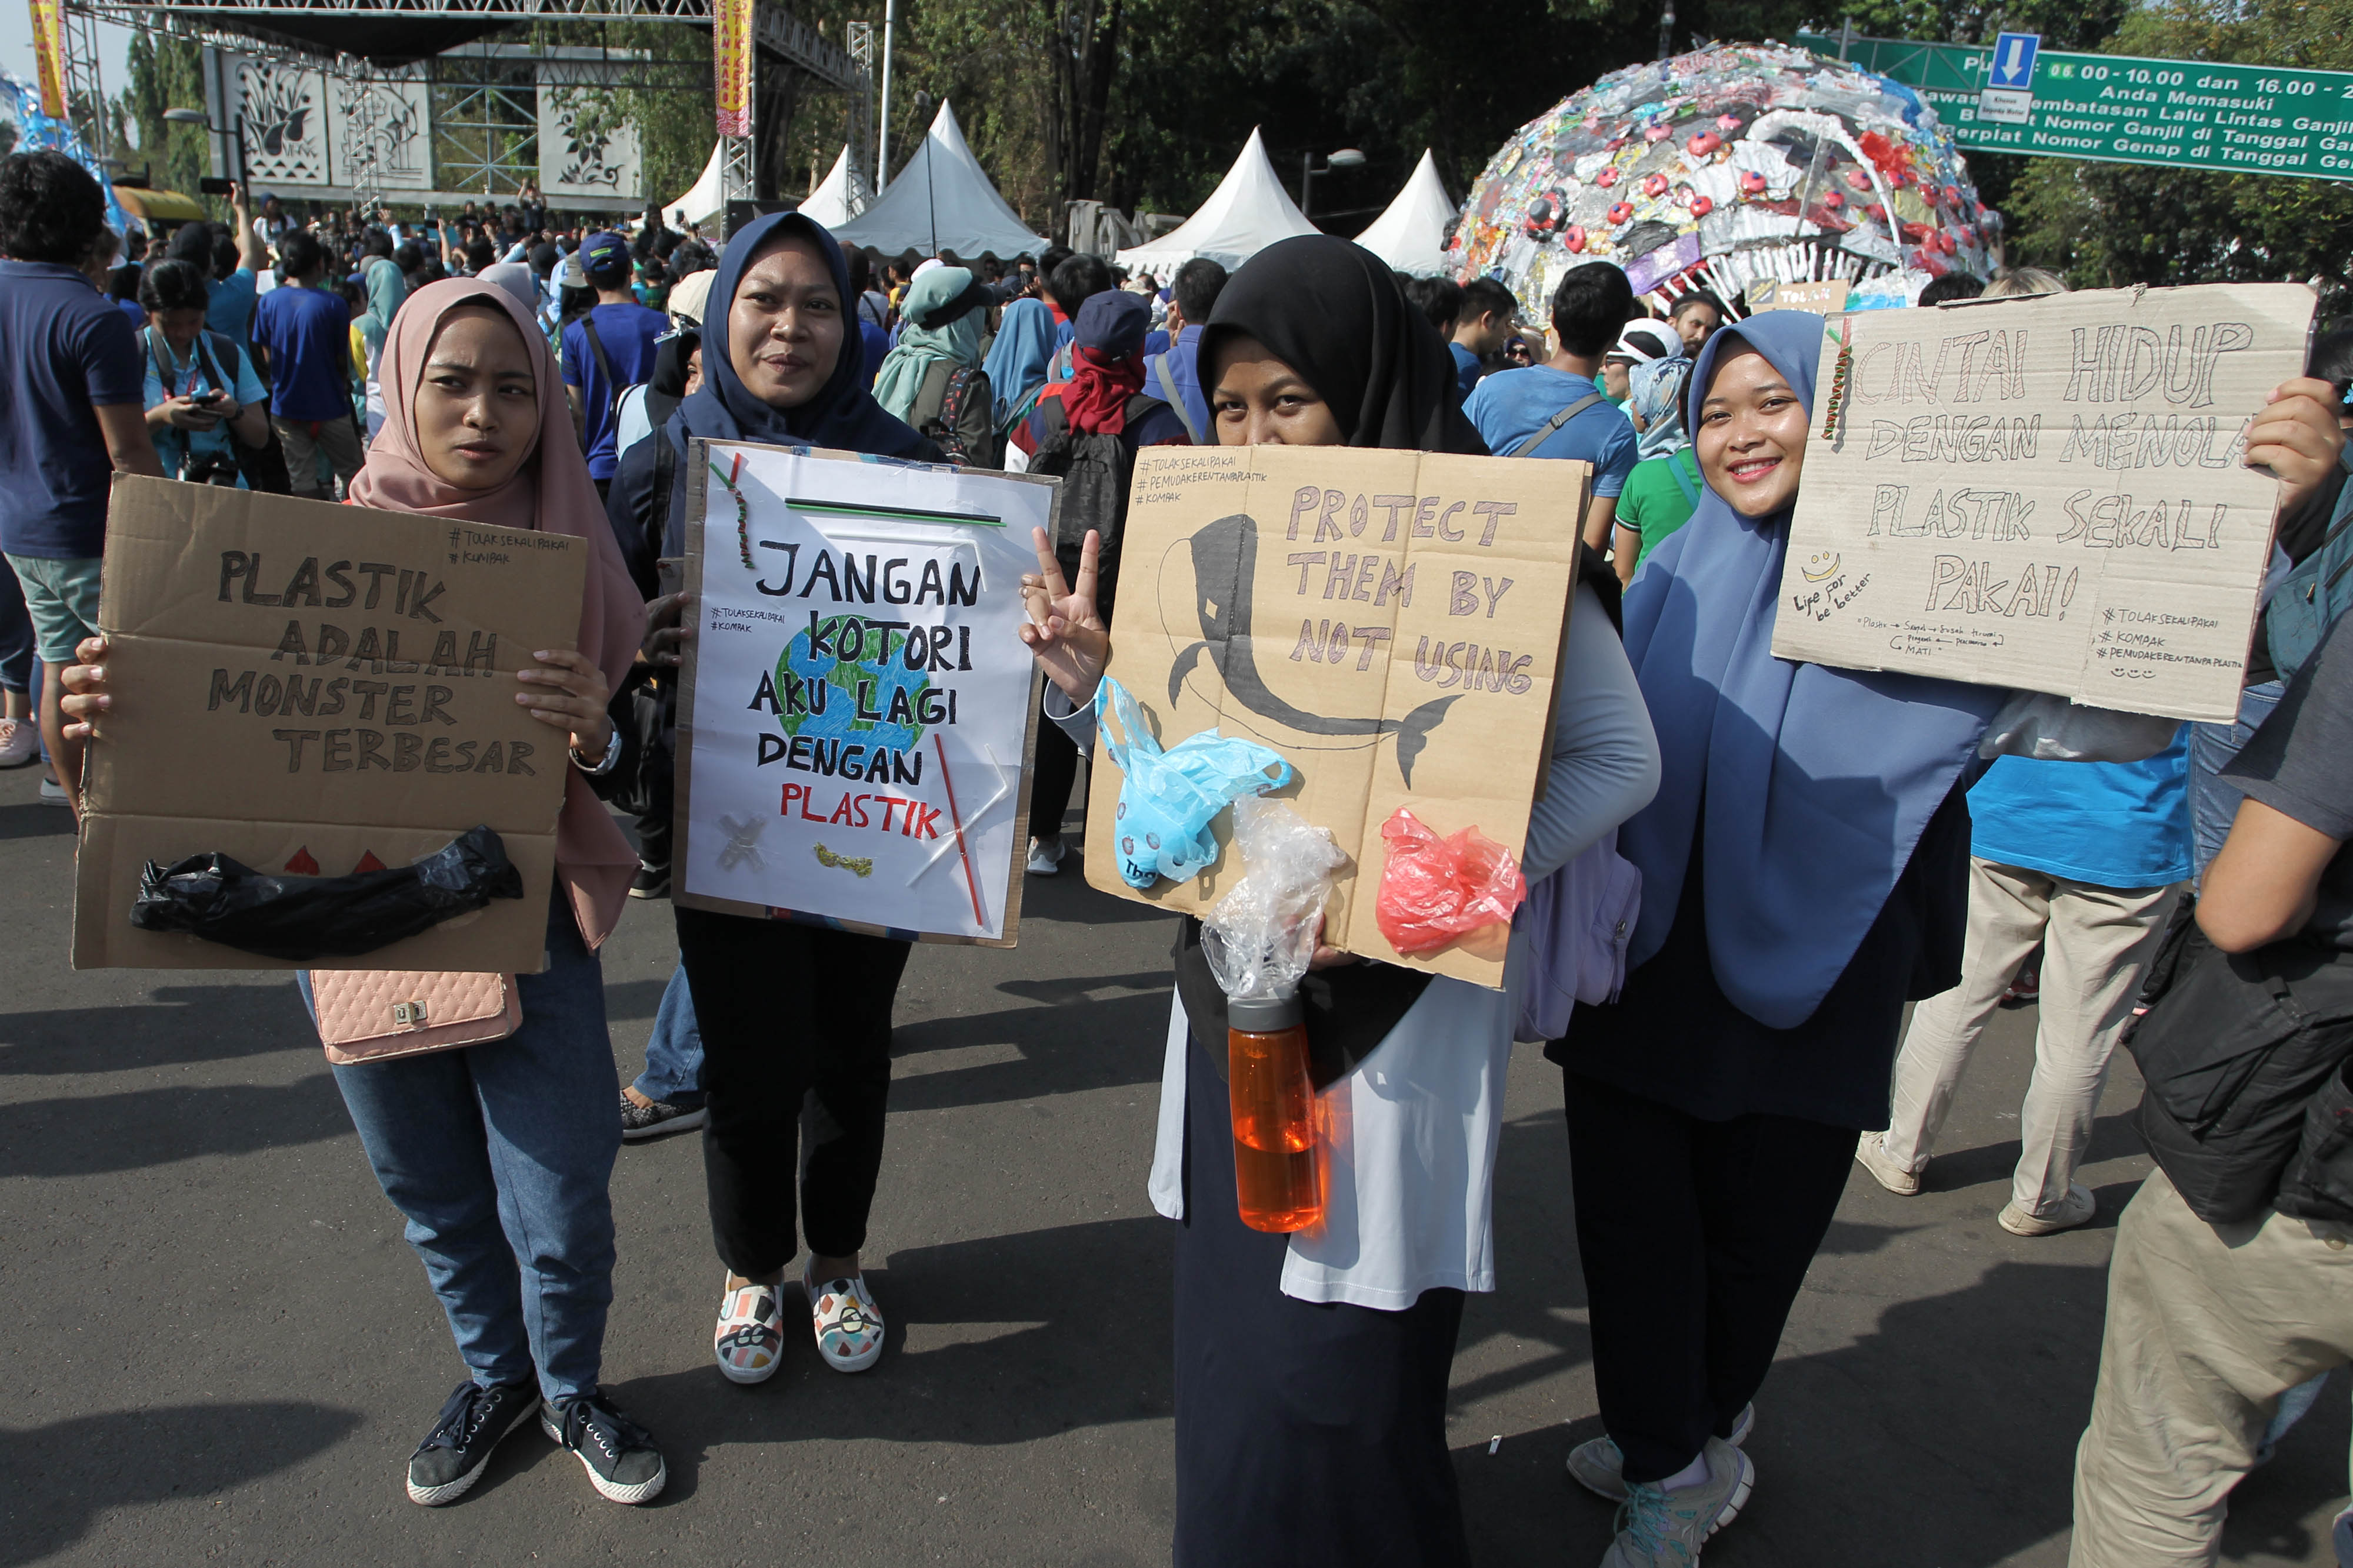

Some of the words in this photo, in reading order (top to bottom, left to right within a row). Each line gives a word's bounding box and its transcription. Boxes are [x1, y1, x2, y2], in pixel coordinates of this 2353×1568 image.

[2099, 85, 2158, 103] Anda
[2167, 91, 2274, 111] Memasuki
[2126, 68, 2184, 86] 10.00
[2196, 75, 2239, 91] dan
[2255, 78, 2316, 96] 16.00
[2031, 94, 2148, 118] embatasan
[2159, 106, 2206, 122] Lalu
[2214, 110, 2282, 129] Lintas
[2292, 116, 2353, 136] Ganjil
[2044, 115, 2115, 134] Nomor
[2123, 120, 2184, 141] Ganjil
[2192, 127, 2212, 141] di
[2222, 129, 2308, 150] Tanggal
[2032, 131, 2103, 149] Nomor
[2112, 138, 2181, 158] Genap
[2189, 145, 2210, 159] di
[2220, 146, 2308, 167] Tanggal
[1855, 329, 2028, 405] CINTAI
[2064, 323, 2253, 408] HIDUP
[1865, 413, 2041, 462] DENGAN
[2059, 412, 2258, 471] MENOLA
[1287, 485, 1518, 547] PROTECT
[1867, 484, 2035, 541] PLASTIK
[2057, 489, 2227, 552] SEKALI
[218, 551, 446, 623] PLASTIK
[756, 541, 981, 606] JANGAN
[1288, 552, 1416, 608] THEM
[1449, 571, 1514, 618] BY
[1816, 608, 1831, 622] be
[1834, 573, 1871, 609] better
[1925, 555, 2078, 621] PAKAI!
[711, 607, 785, 624] #TOLAKSEKALIPAKAI
[711, 622, 752, 633] #KOMPAK
[810, 610, 974, 672] KOTORI
[271, 620, 497, 678] ADALAH
[1289, 619, 1391, 672] NOT
[1415, 635, 1533, 695] USING
[208, 668, 457, 725] MONSTER
[747, 670, 825, 716] AKU
[856, 679, 957, 725] LAGI
[272, 728, 536, 777] TERBESAR
[756, 733, 922, 786] DENGAN
[781, 782, 941, 840] PLASTIK
